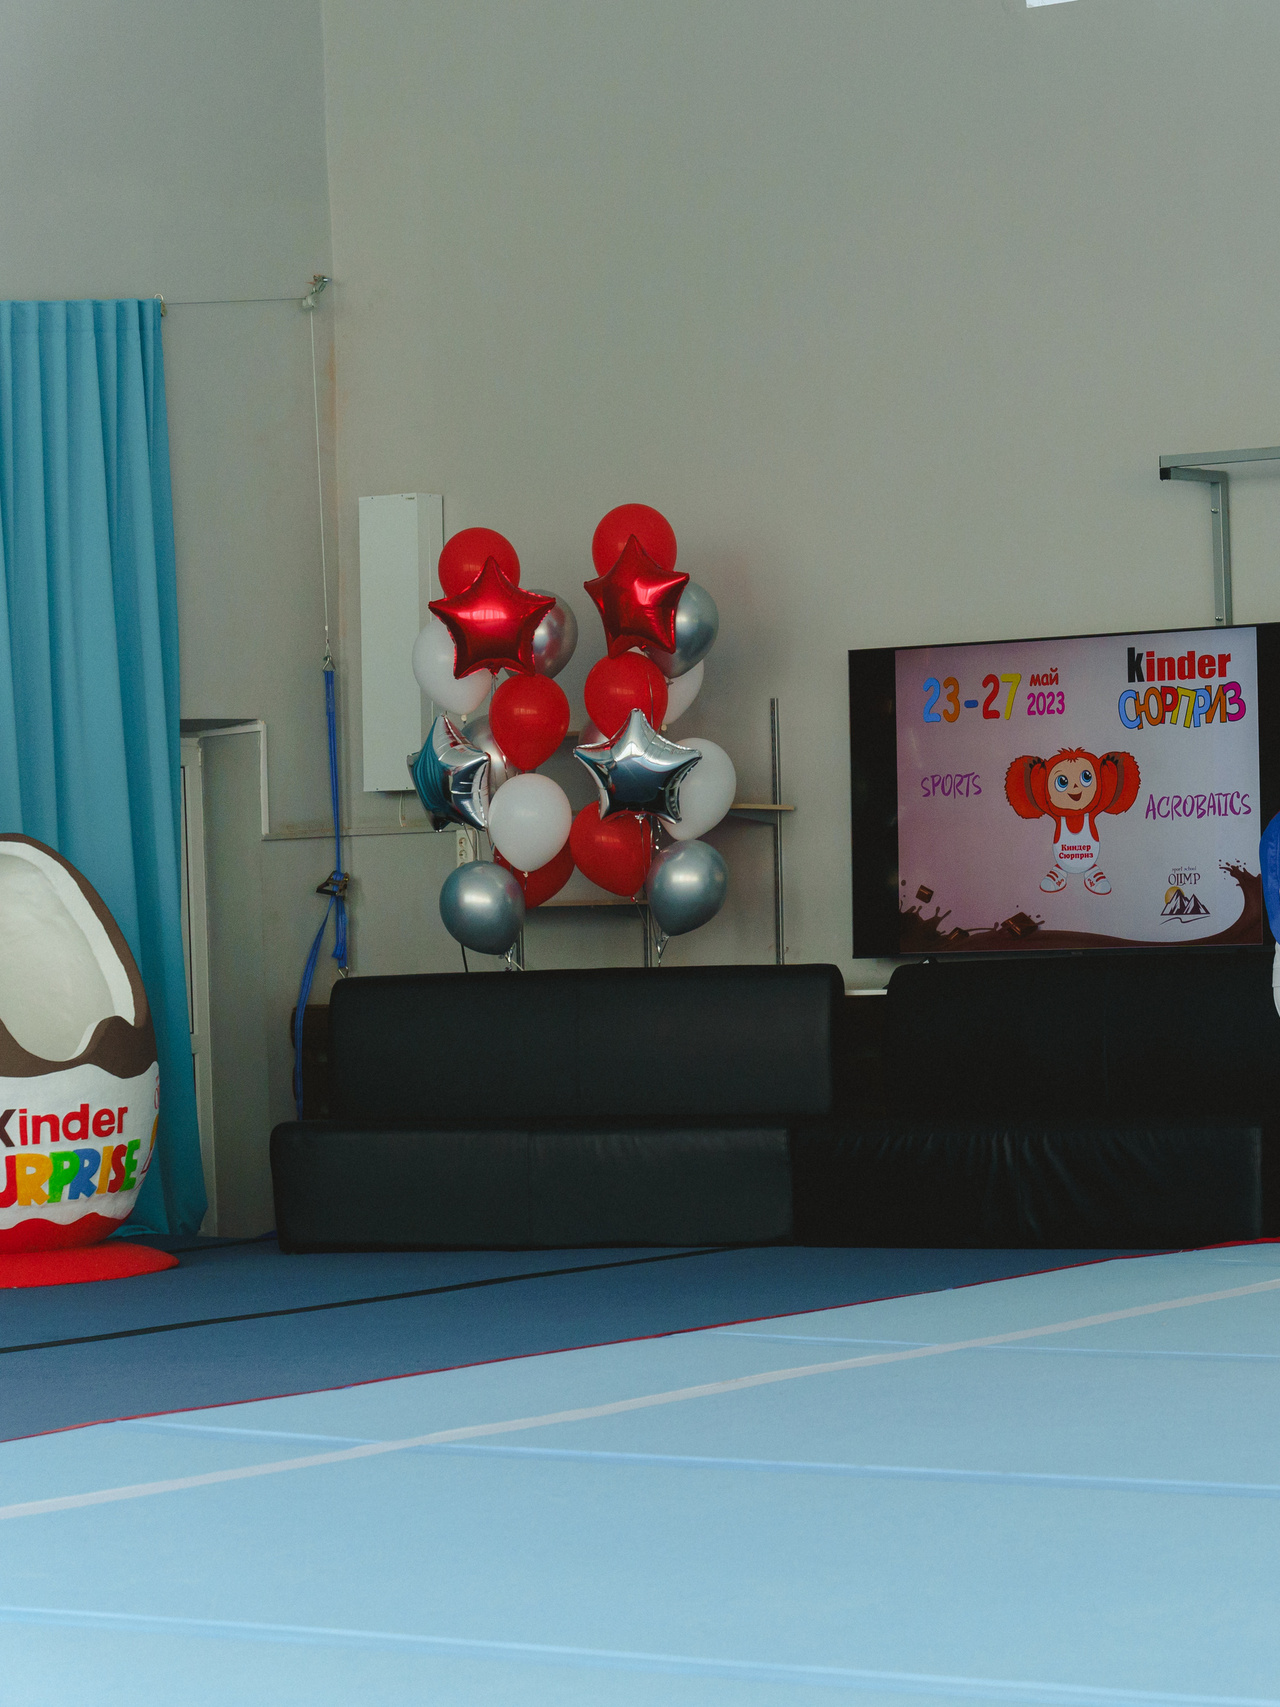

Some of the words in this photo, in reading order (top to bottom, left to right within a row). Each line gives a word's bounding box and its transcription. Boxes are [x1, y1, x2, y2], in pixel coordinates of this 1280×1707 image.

[1127, 647, 1231, 683] kinder
[923, 673, 1022, 723] 23-27
[1029, 667, 1059, 687] май
[1027, 691, 1066, 716] 2023
[1118, 681, 1246, 730] СЮРПРИЗ
[920, 772, 982, 798] SPORTS
[1145, 791, 1252, 820] ACROBATICS
[1058, 852, 1094, 860] Сюрприз
[1061, 844, 1091, 852] Киндер
